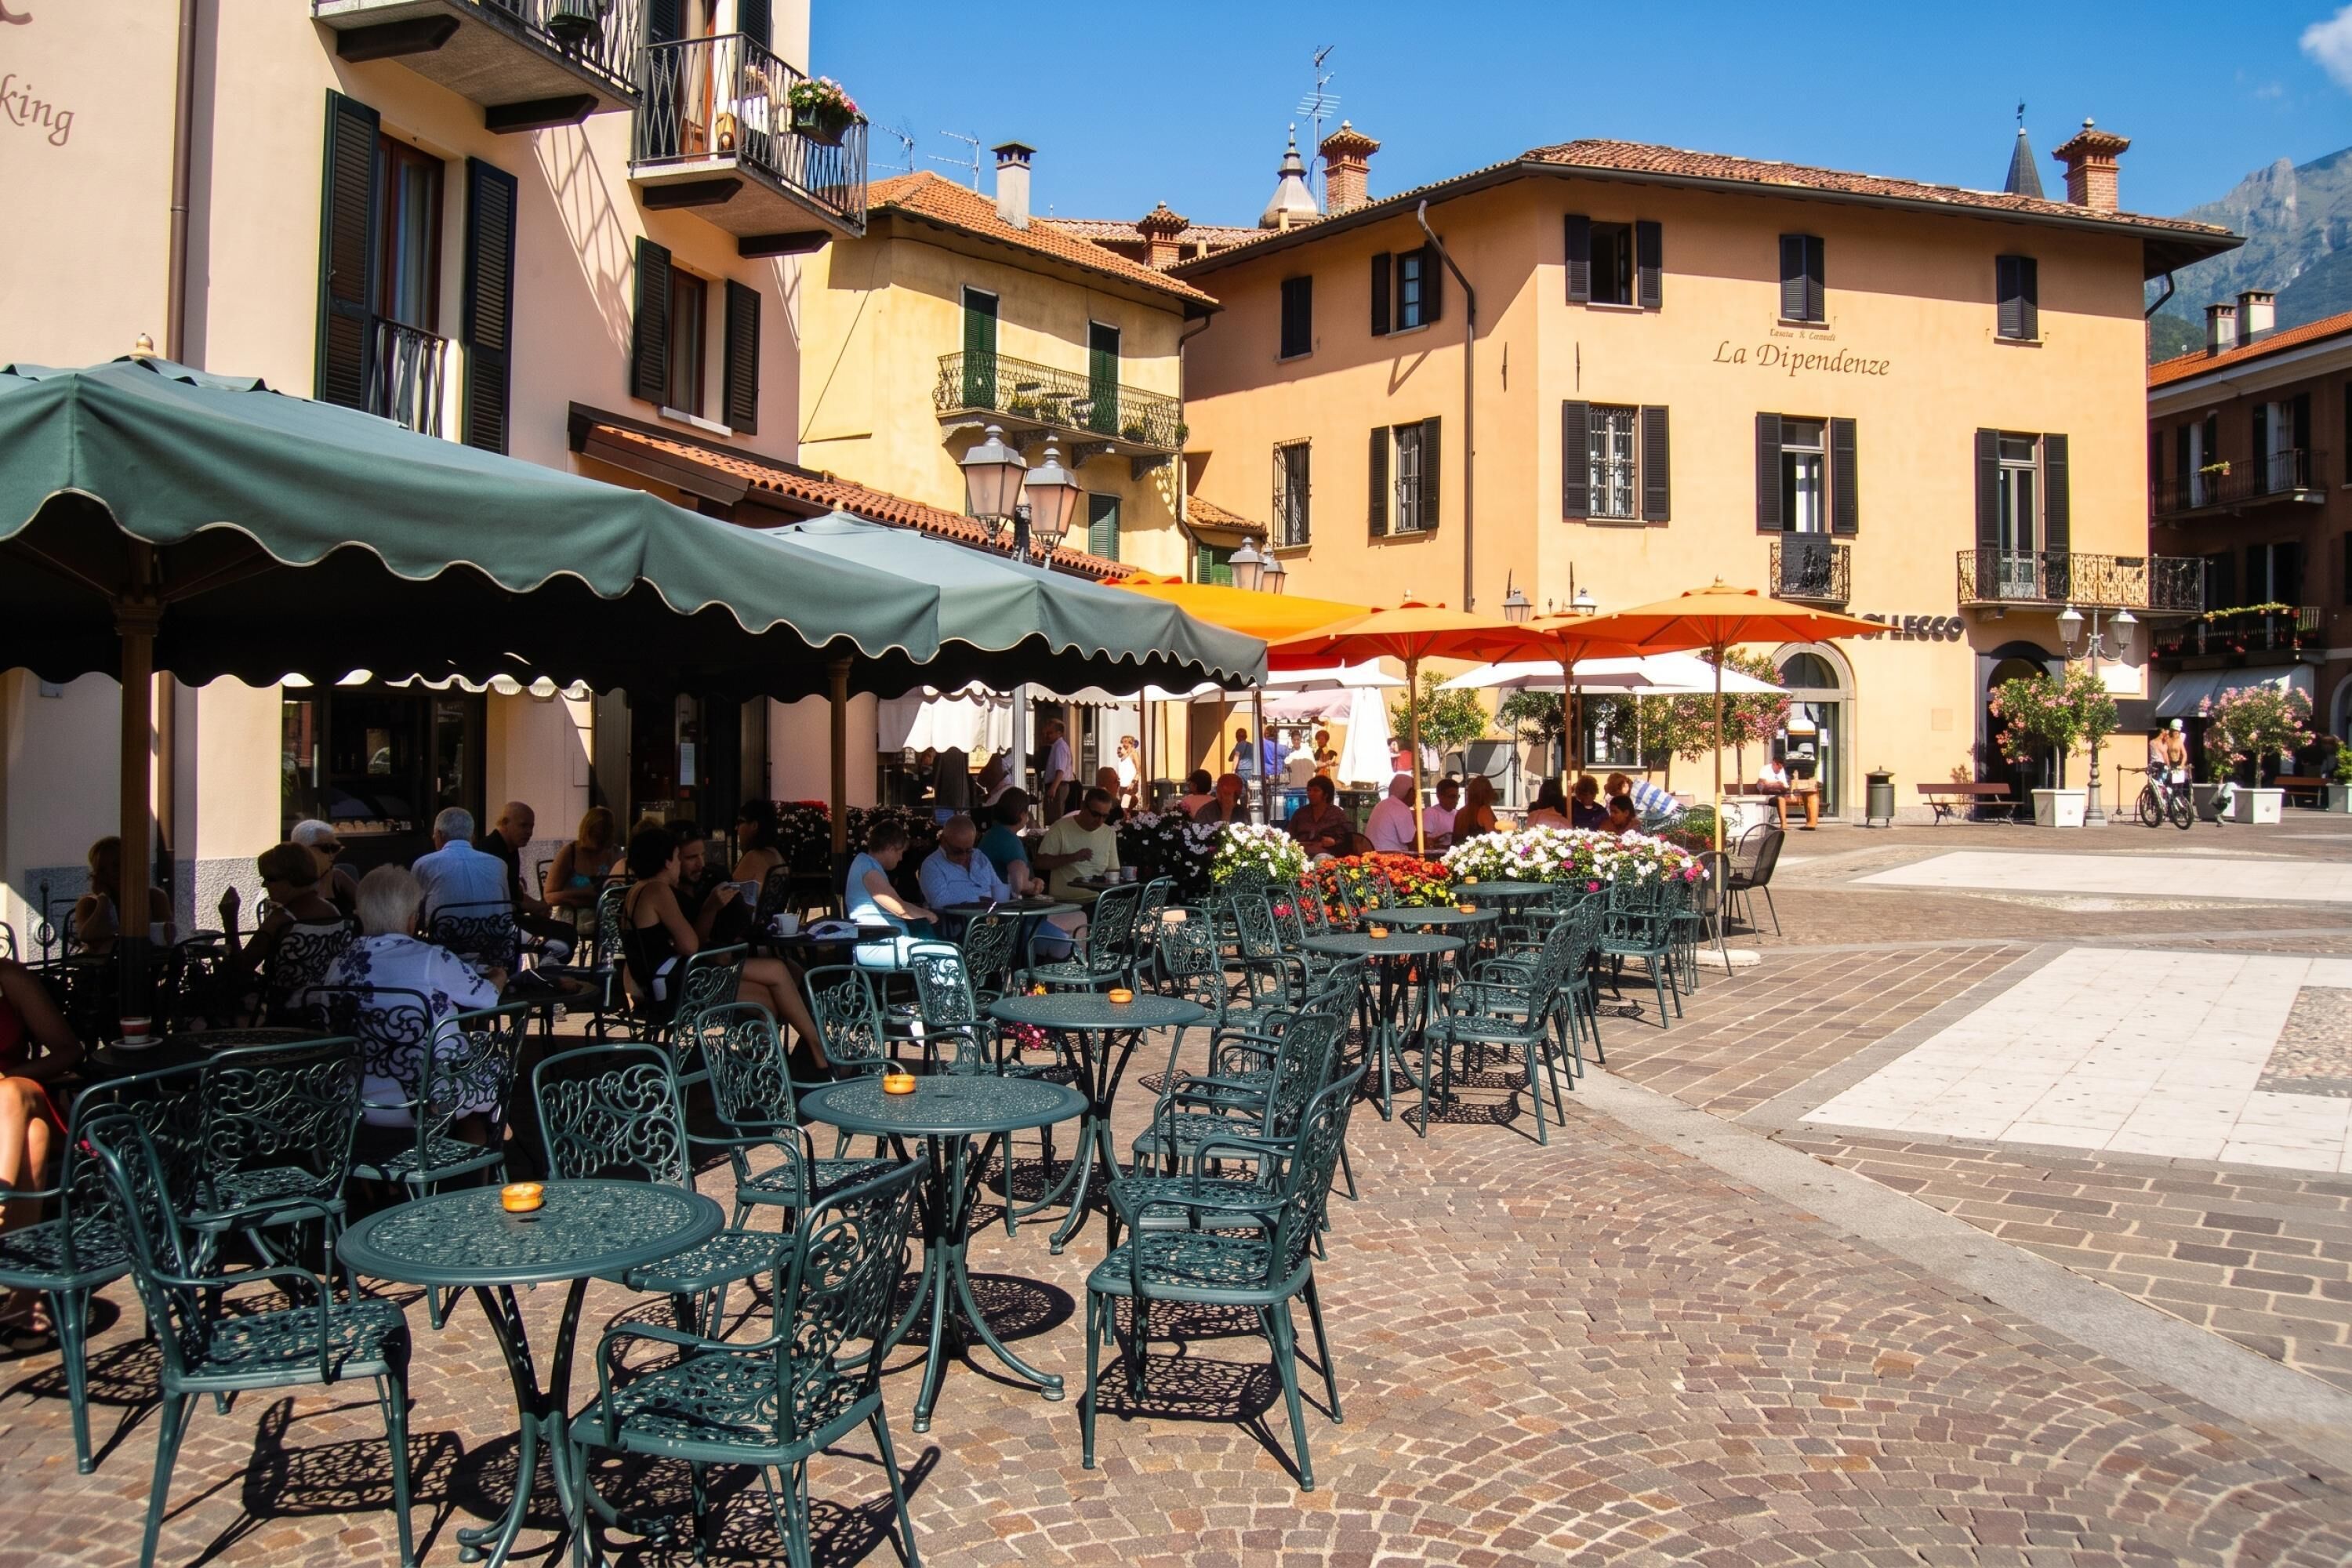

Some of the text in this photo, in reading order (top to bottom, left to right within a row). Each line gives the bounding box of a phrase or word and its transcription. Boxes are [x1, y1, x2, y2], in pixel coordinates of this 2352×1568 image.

[1712, 340, 1890, 377] La Dipendenze
[1889, 615, 1965, 642] LECCO
